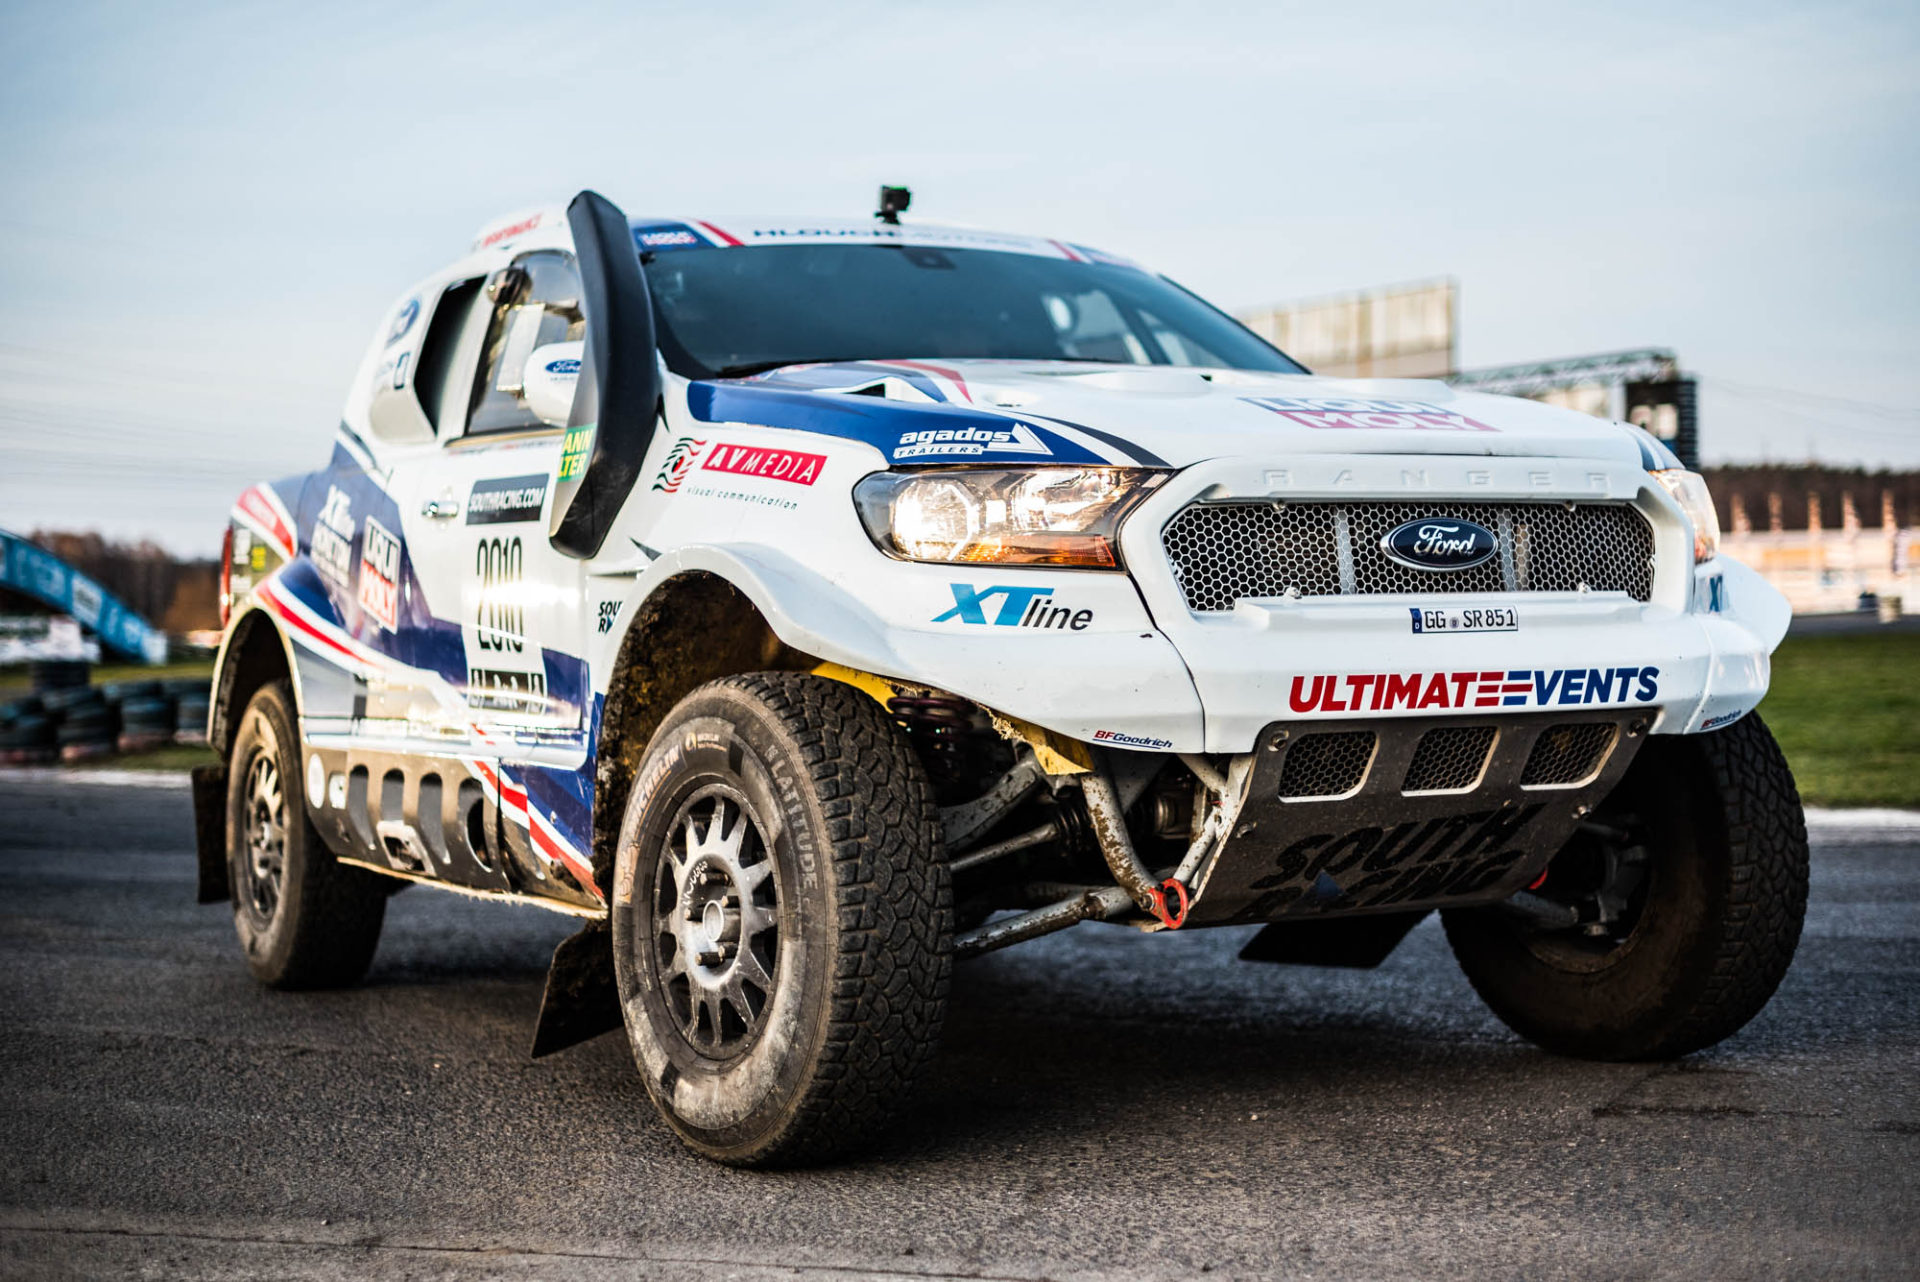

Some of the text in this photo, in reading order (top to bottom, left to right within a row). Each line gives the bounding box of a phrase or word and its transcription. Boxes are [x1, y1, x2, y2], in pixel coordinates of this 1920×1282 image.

[1248, 397, 1450, 413] LIQUI
[1286, 412, 1480, 431] MOLY
[899, 427, 1012, 447] agados
[899, 446, 980, 457] TRAILERS
[1262, 469, 1612, 488] RANGER
[687, 487, 798, 512] visual communication
[1414, 524, 1476, 555] Ford
[476, 536, 524, 654] 2010
[1424, 611, 1446, 629] GG
[1094, 729, 1173, 749] BFGoodrich
[770, 758, 819, 890] LATITUDE
